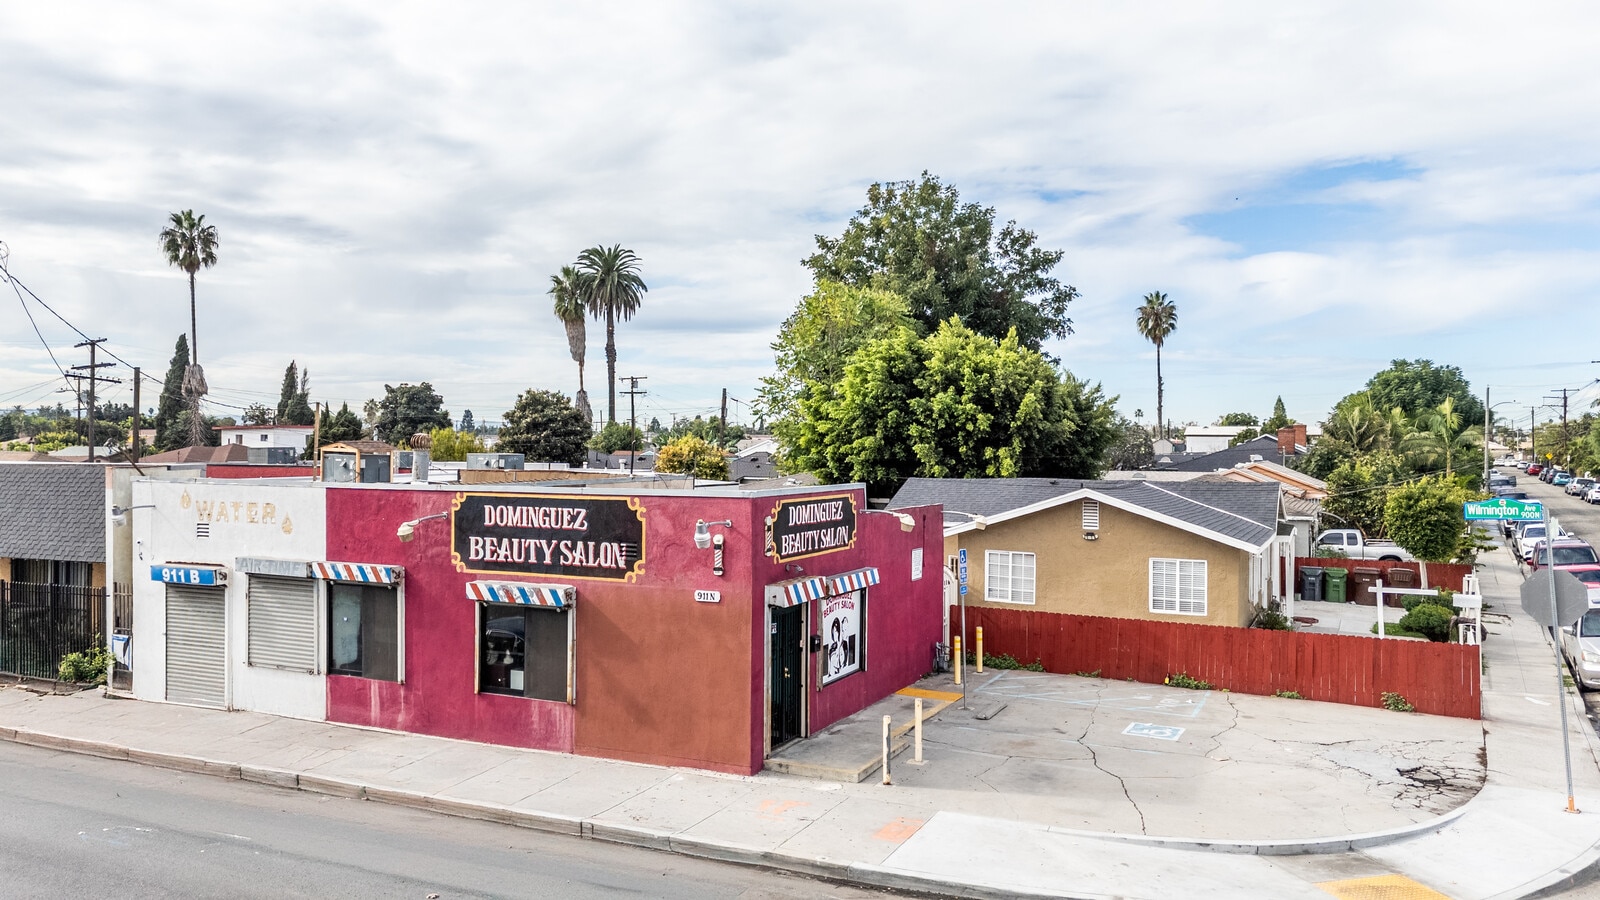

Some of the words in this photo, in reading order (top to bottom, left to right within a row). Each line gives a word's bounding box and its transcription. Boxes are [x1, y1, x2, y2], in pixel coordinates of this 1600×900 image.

[195, 500, 276, 524] WATER
[484, 504, 588, 532] DOMINGUEZ
[788, 501, 843, 526] DOMINGUEZ
[1467, 504, 1519, 518] Wilmington
[1524, 504, 1536, 512] Ave
[469, 536, 557, 565] BEAUTY
[560, 540, 627, 569] SALON
[781, 530, 820, 556] BEAUTY
[820, 525, 849, 548] SALON
[162, 568, 185, 583] 911
[189, 569, 200, 584] B
[823, 603, 840, 618] BEAUTY
[841, 600, 855, 610] SALON
